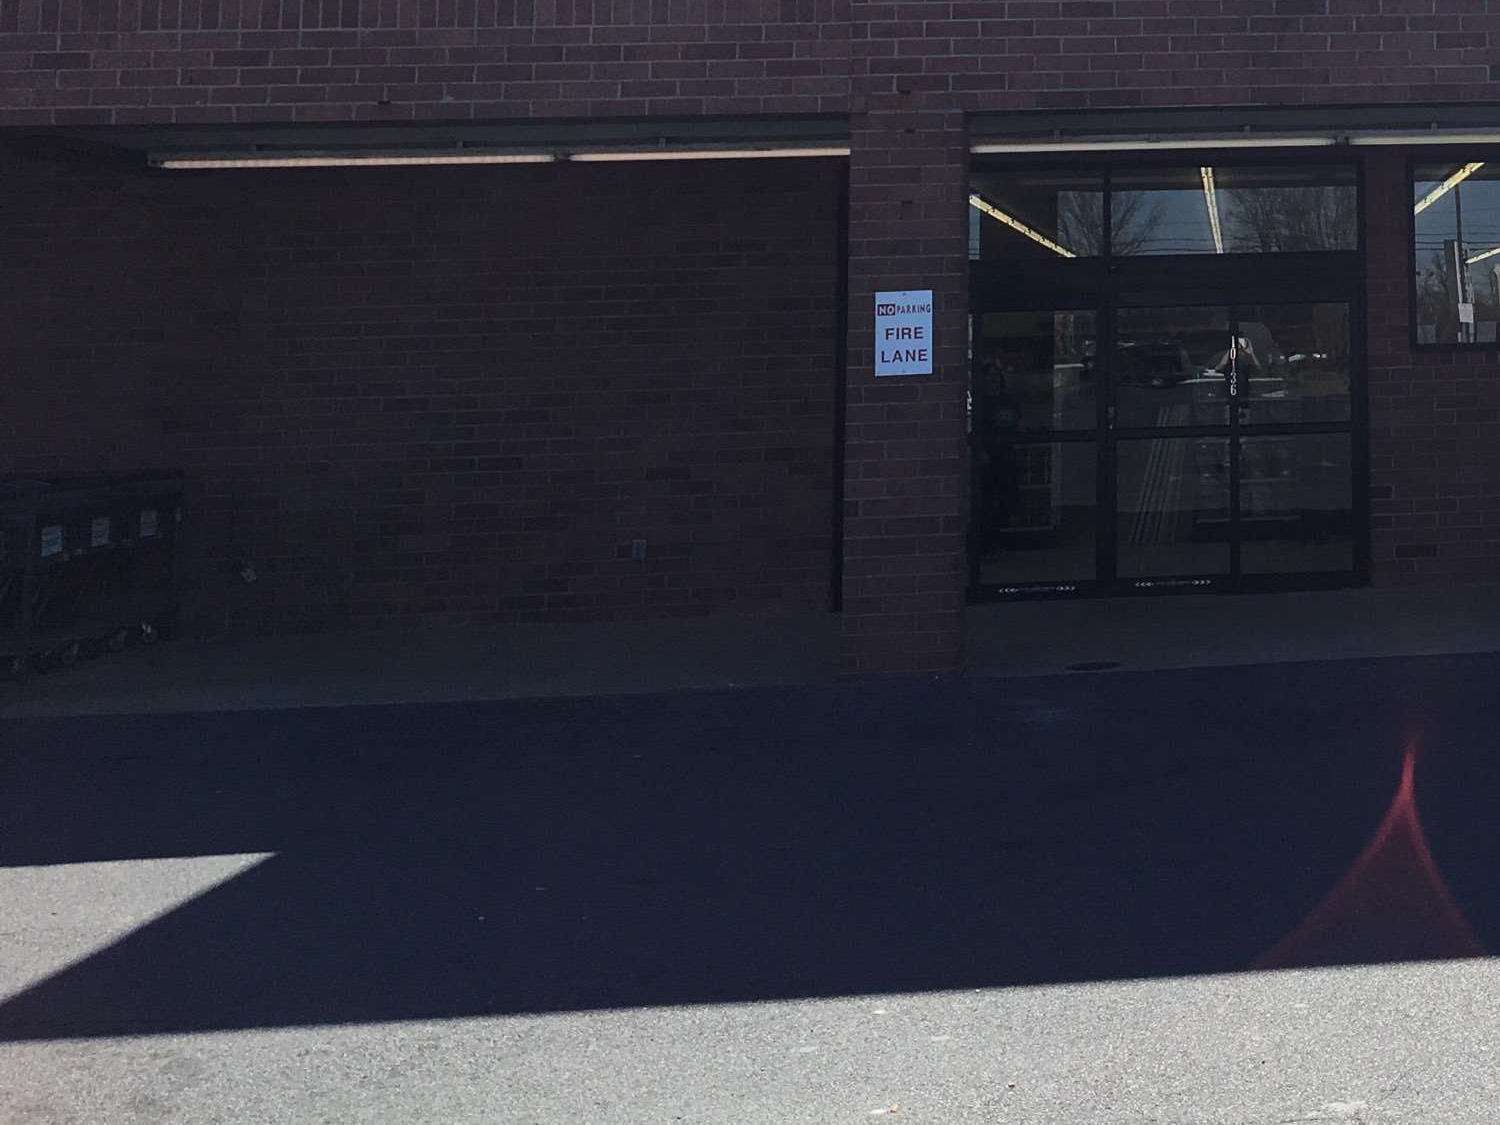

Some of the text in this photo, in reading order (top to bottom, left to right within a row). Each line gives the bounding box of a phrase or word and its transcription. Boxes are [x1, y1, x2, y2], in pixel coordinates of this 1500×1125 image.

[878, 304, 931, 315] NO PARKING
[885, 326, 924, 340] FIRE
[881, 349, 928, 363] LANE
